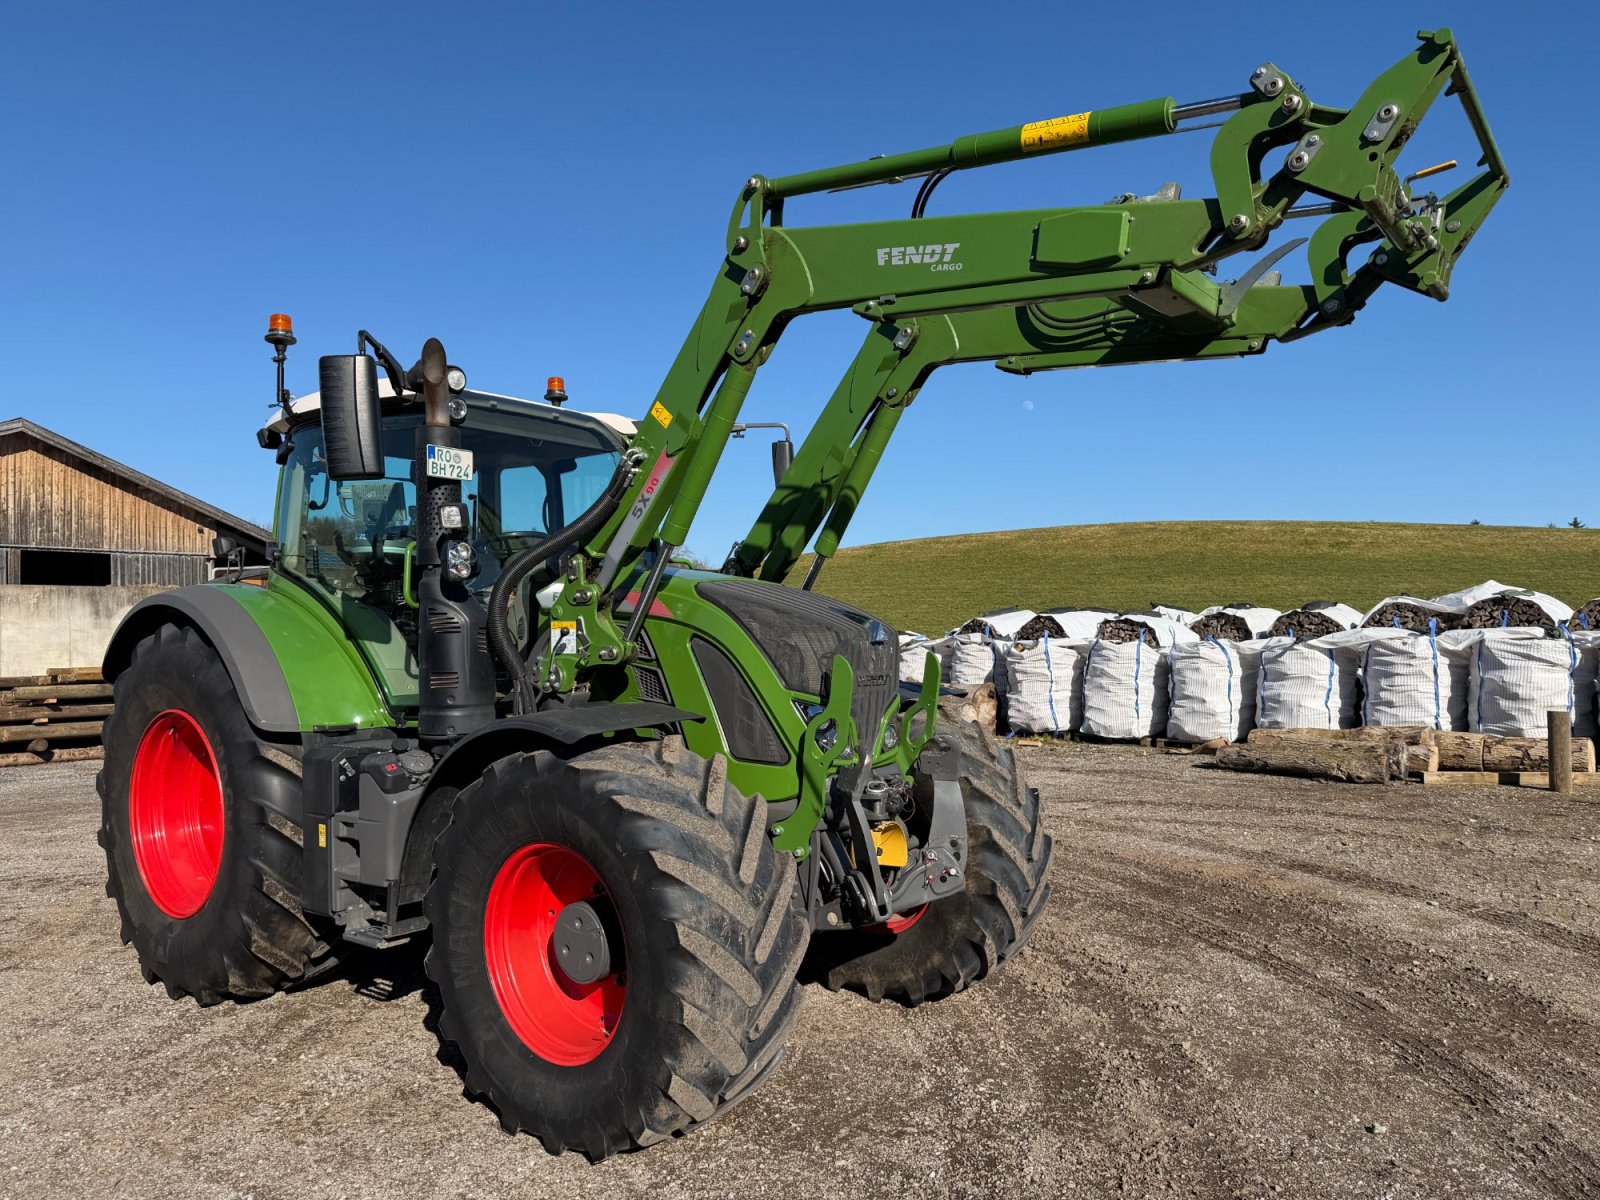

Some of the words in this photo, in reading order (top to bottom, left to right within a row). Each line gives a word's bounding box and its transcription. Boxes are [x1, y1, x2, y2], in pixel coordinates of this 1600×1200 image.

[876, 243, 961, 266] FENDT
[930, 262, 963, 272] CARGO
[437, 449, 452, 463] RO
[431, 462, 446, 476] BH
[449, 464, 470, 479] 724
